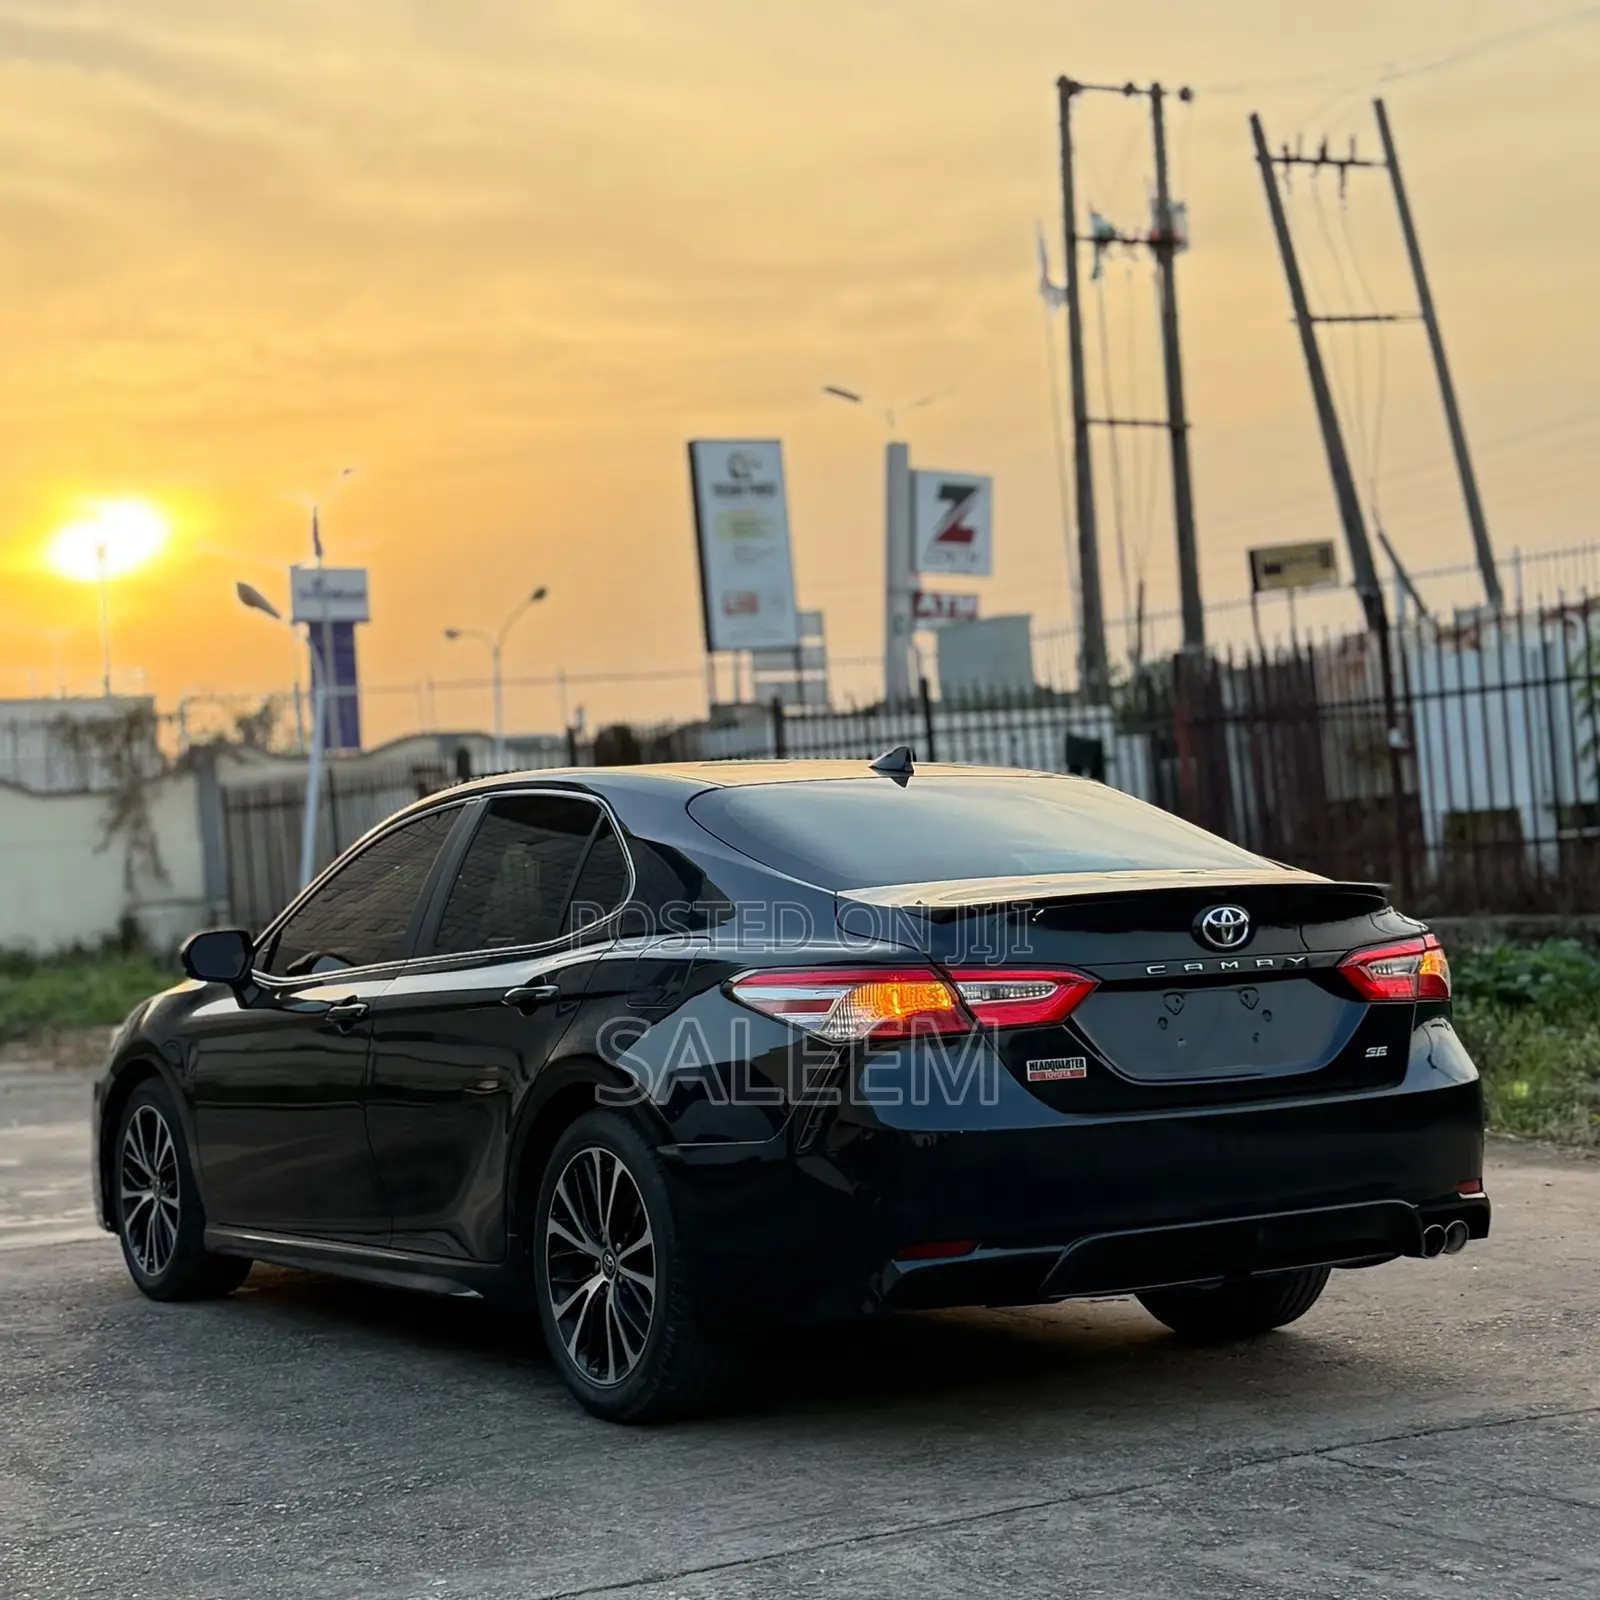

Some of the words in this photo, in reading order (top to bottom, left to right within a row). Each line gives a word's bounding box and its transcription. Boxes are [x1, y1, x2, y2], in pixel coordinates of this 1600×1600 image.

[1146, 956, 1305, 975] CAMRY
[1364, 1046, 1388, 1058] SE
[1028, 1058, 1085, 1072] HEADQUARTER
[1044, 1070, 1072, 1078] TOYOTA
